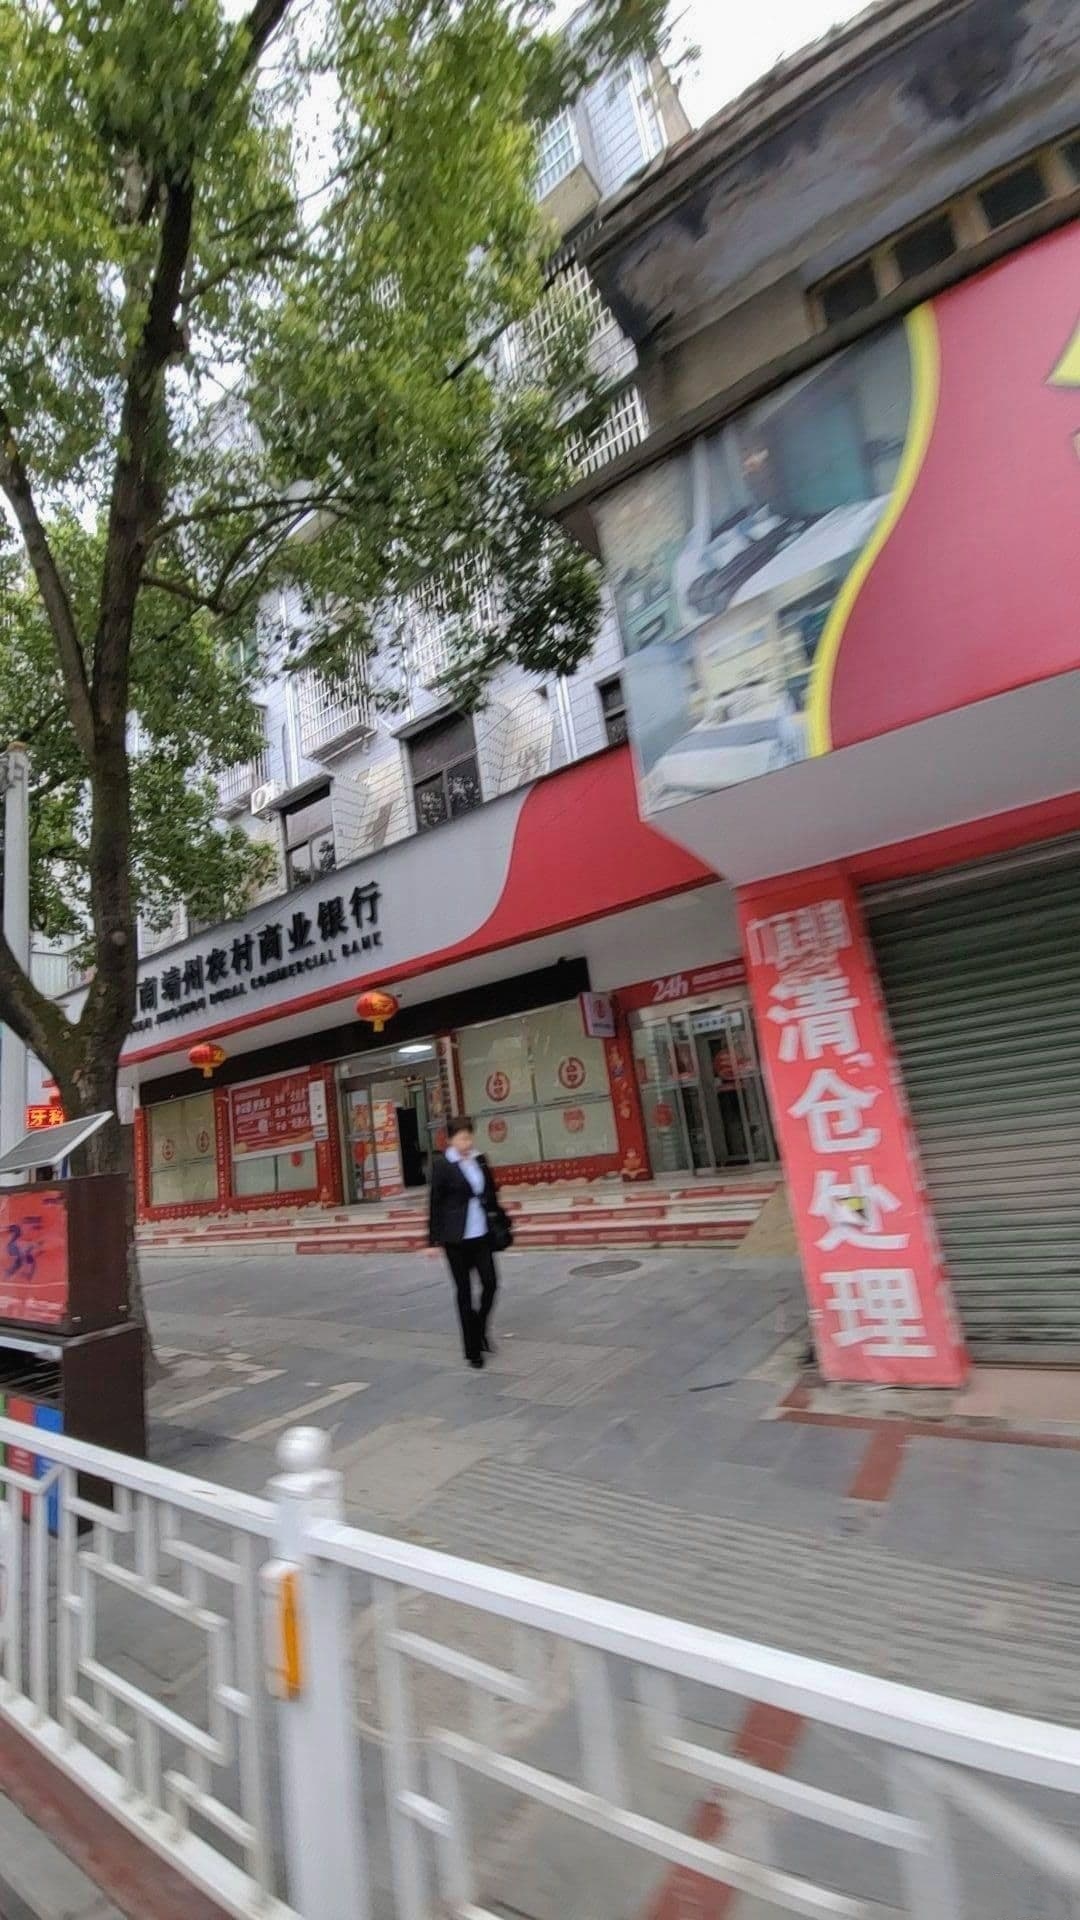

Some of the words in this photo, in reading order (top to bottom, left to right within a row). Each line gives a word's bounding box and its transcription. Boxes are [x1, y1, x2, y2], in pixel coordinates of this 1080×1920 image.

[251, 950, 336, 989] COMMERCIAL
[342, 931, 383, 957] BANK
[652, 975, 689, 1001] 24h
